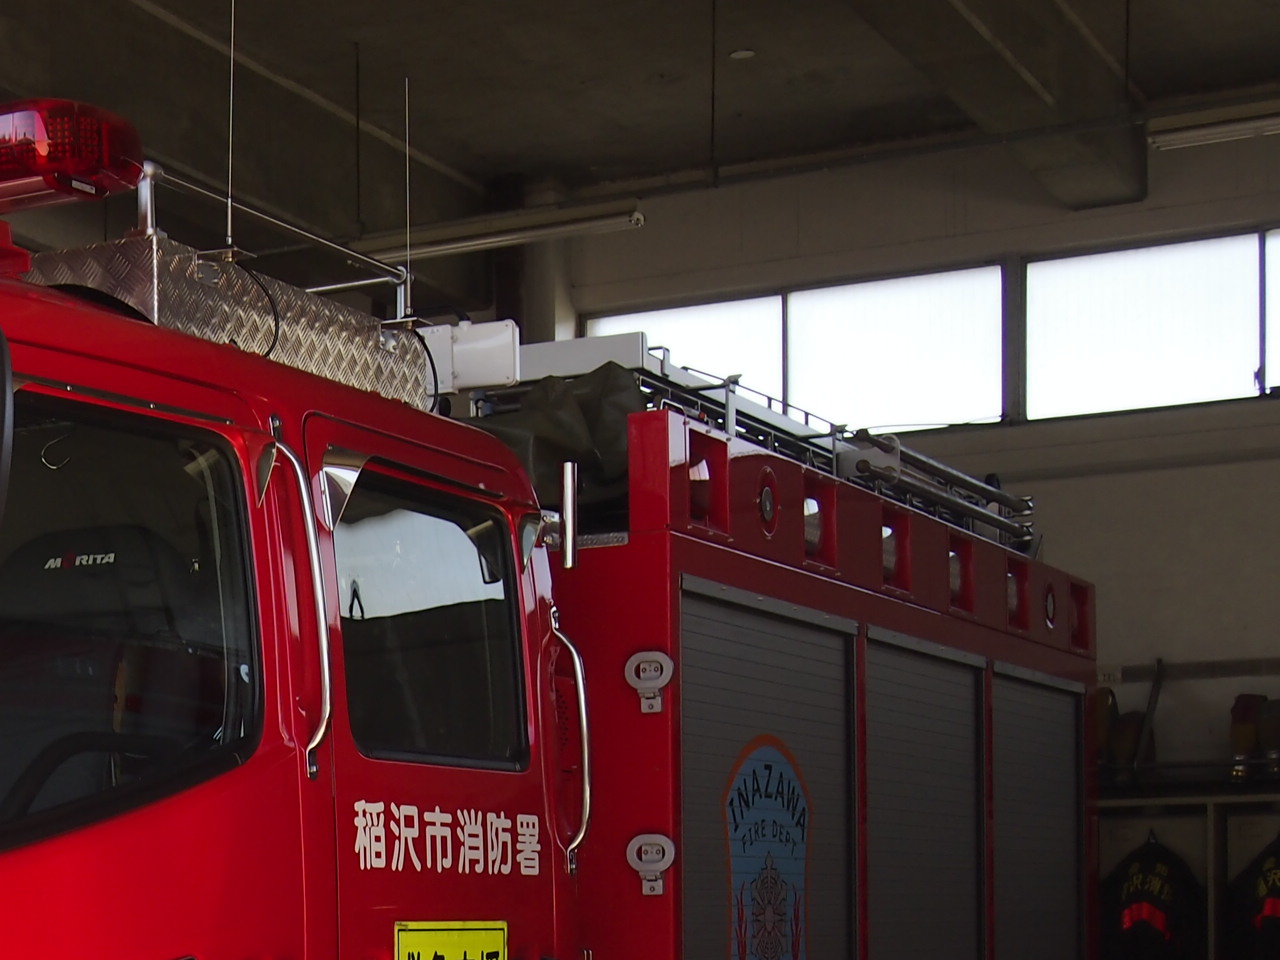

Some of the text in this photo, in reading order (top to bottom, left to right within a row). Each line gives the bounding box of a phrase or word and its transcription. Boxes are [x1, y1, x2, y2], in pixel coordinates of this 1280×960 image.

[354, 799, 541, 876] 稲沢市消防署
[729, 764, 806, 843] INAZAWA
[742, 819, 767, 854] FIRE
